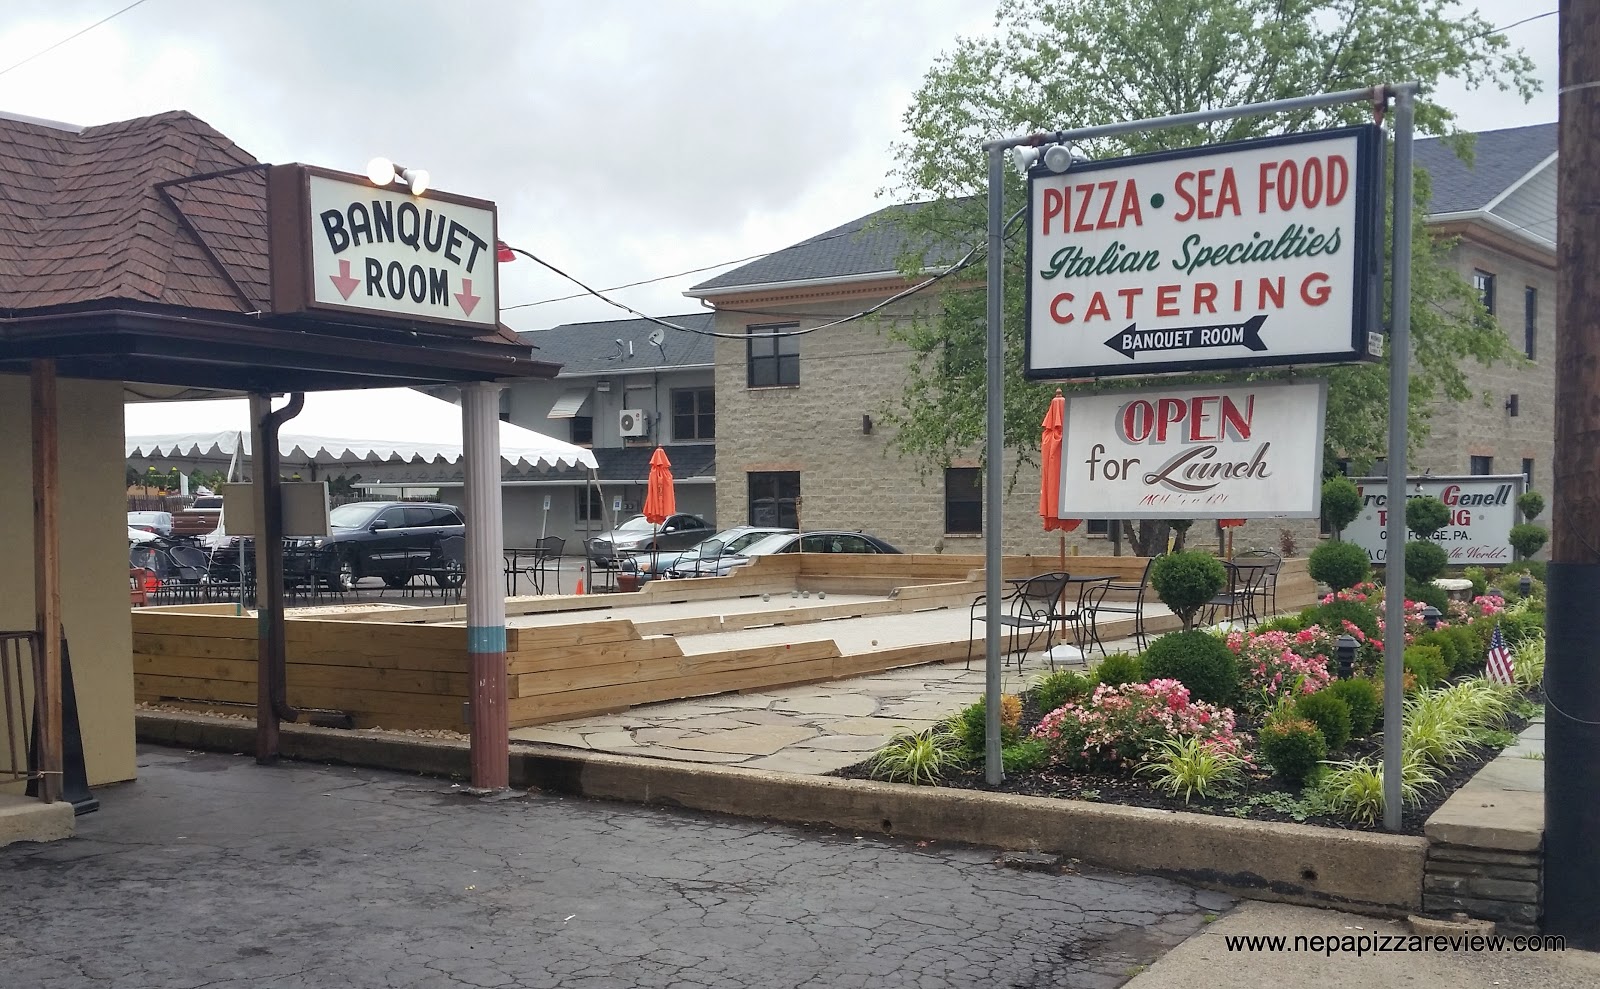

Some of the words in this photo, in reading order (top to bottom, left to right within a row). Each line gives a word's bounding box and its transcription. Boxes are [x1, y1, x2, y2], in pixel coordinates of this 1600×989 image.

[1042, 178, 1143, 236] PIZZA
[1173, 166, 1242, 223] SEA
[1258, 154, 1349, 214] FOOD
[320, 200, 489, 274] BANQUET
[1040, 240, 1160, 281] Italian
[1172, 223, 1342, 276] Specialties
[365, 256, 450, 307] ROOM
[1049, 272, 1332, 325] CATERING
[1121, 330, 1194, 350] BANQUET
[1200, 326, 1245, 345] ROOM
[1116, 394, 1255, 445] OPEN
[1085, 443, 1141, 481] for
[1142, 441, 1273, 493] Lunch
[1441, 484, 1513, 507] Genell
